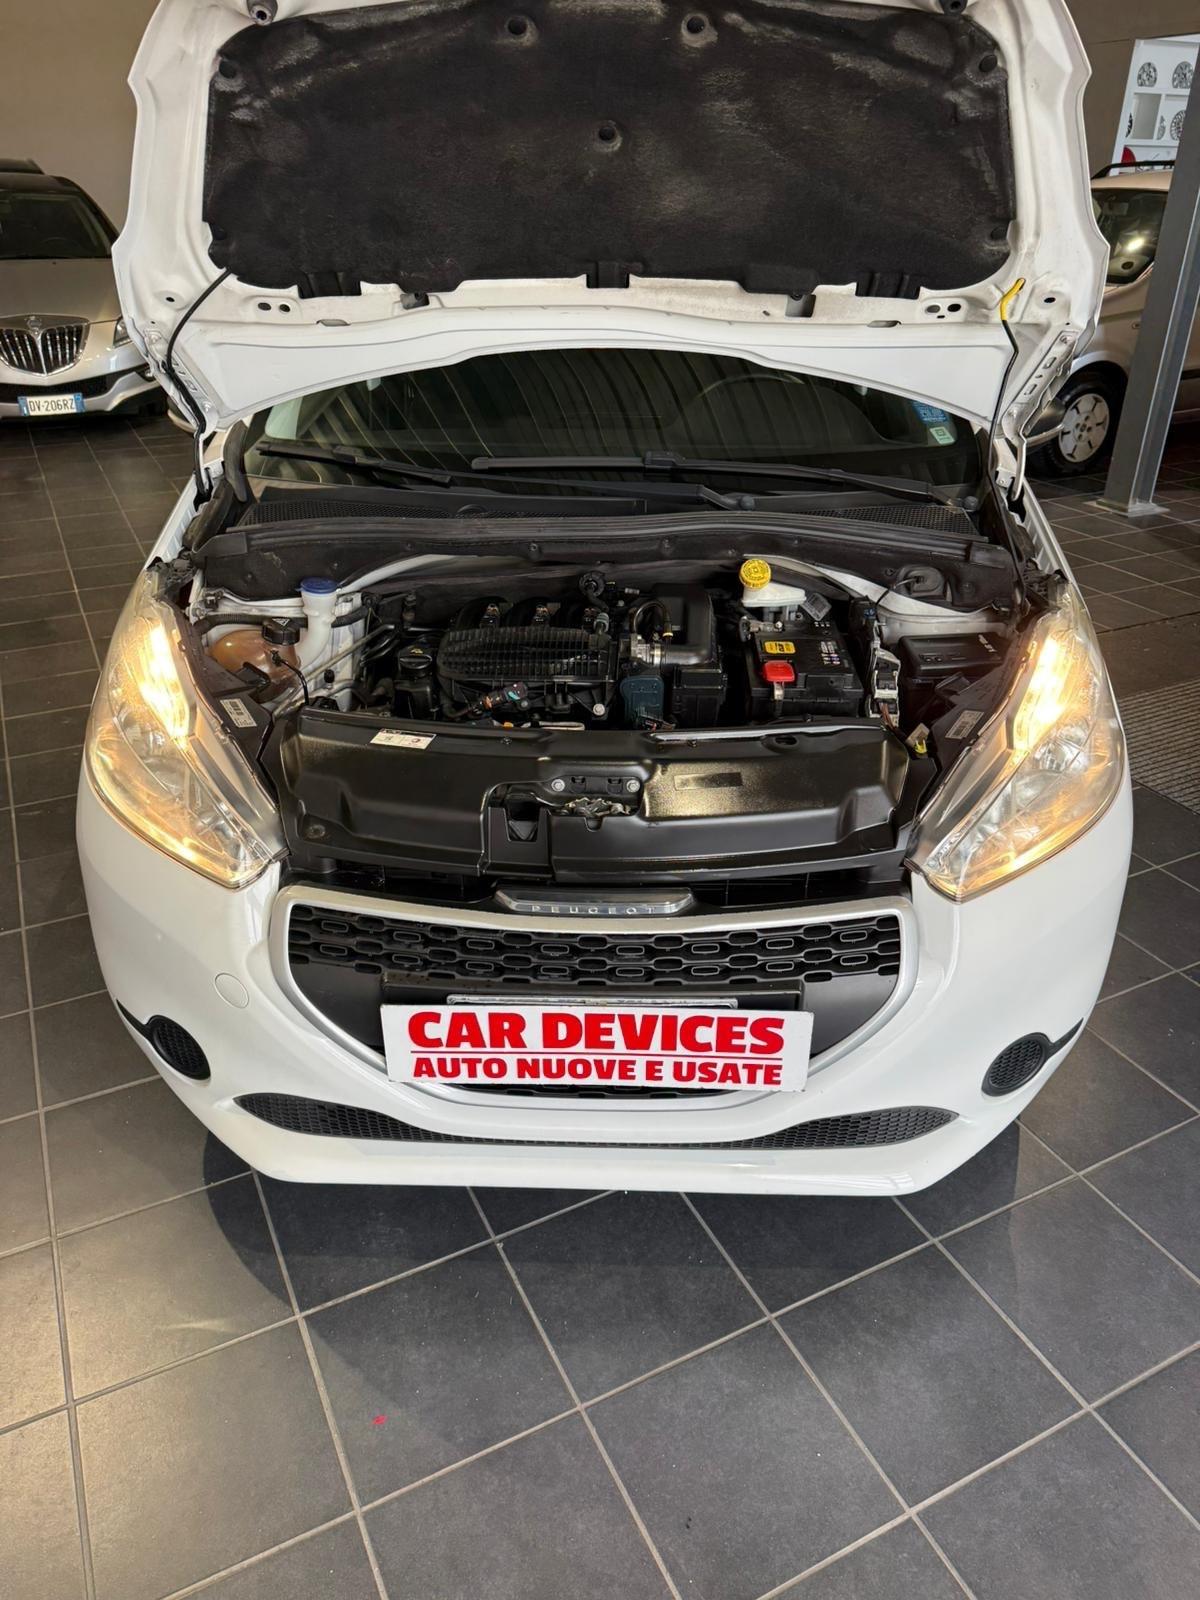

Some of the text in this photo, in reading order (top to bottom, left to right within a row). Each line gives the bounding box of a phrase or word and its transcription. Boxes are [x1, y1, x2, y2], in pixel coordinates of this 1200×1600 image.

[531, 904, 654, 915] PEUGEOT
[409, 1012, 784, 1054] CAR DEVICES
[414, 1058, 782, 1086] AUTO NUOVE E USATE
